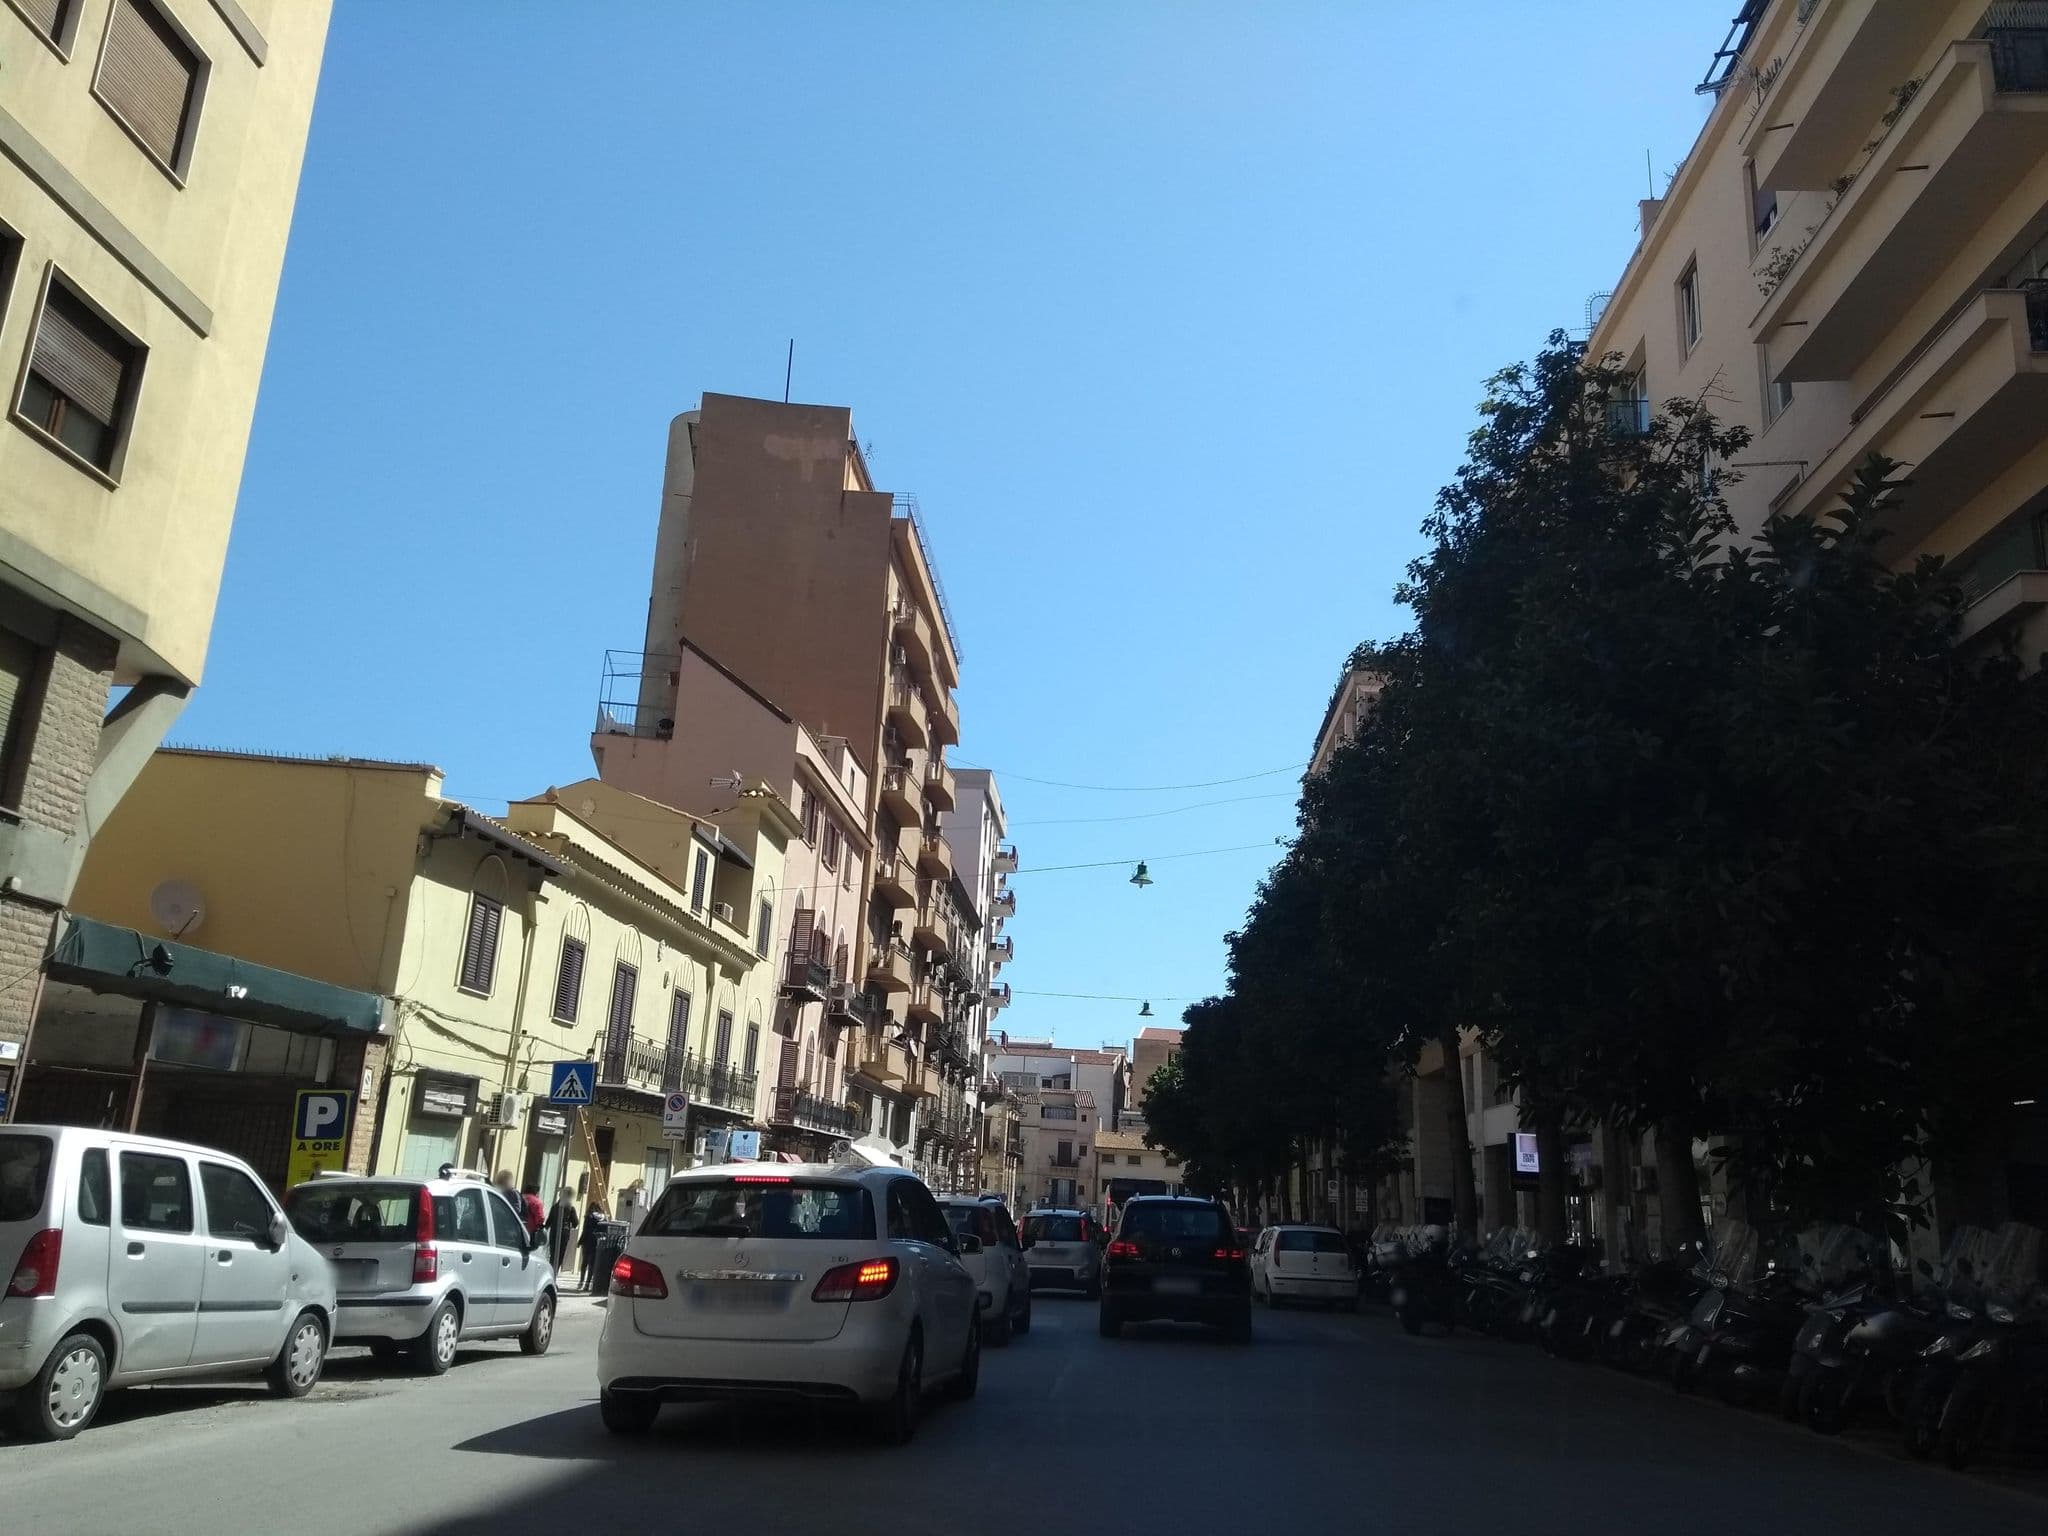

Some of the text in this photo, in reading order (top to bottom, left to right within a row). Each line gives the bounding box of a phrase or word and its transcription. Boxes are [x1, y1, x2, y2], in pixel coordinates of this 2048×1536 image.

[304, 1096, 339, 1137] P
[297, 1141, 340, 1152] A ORE
